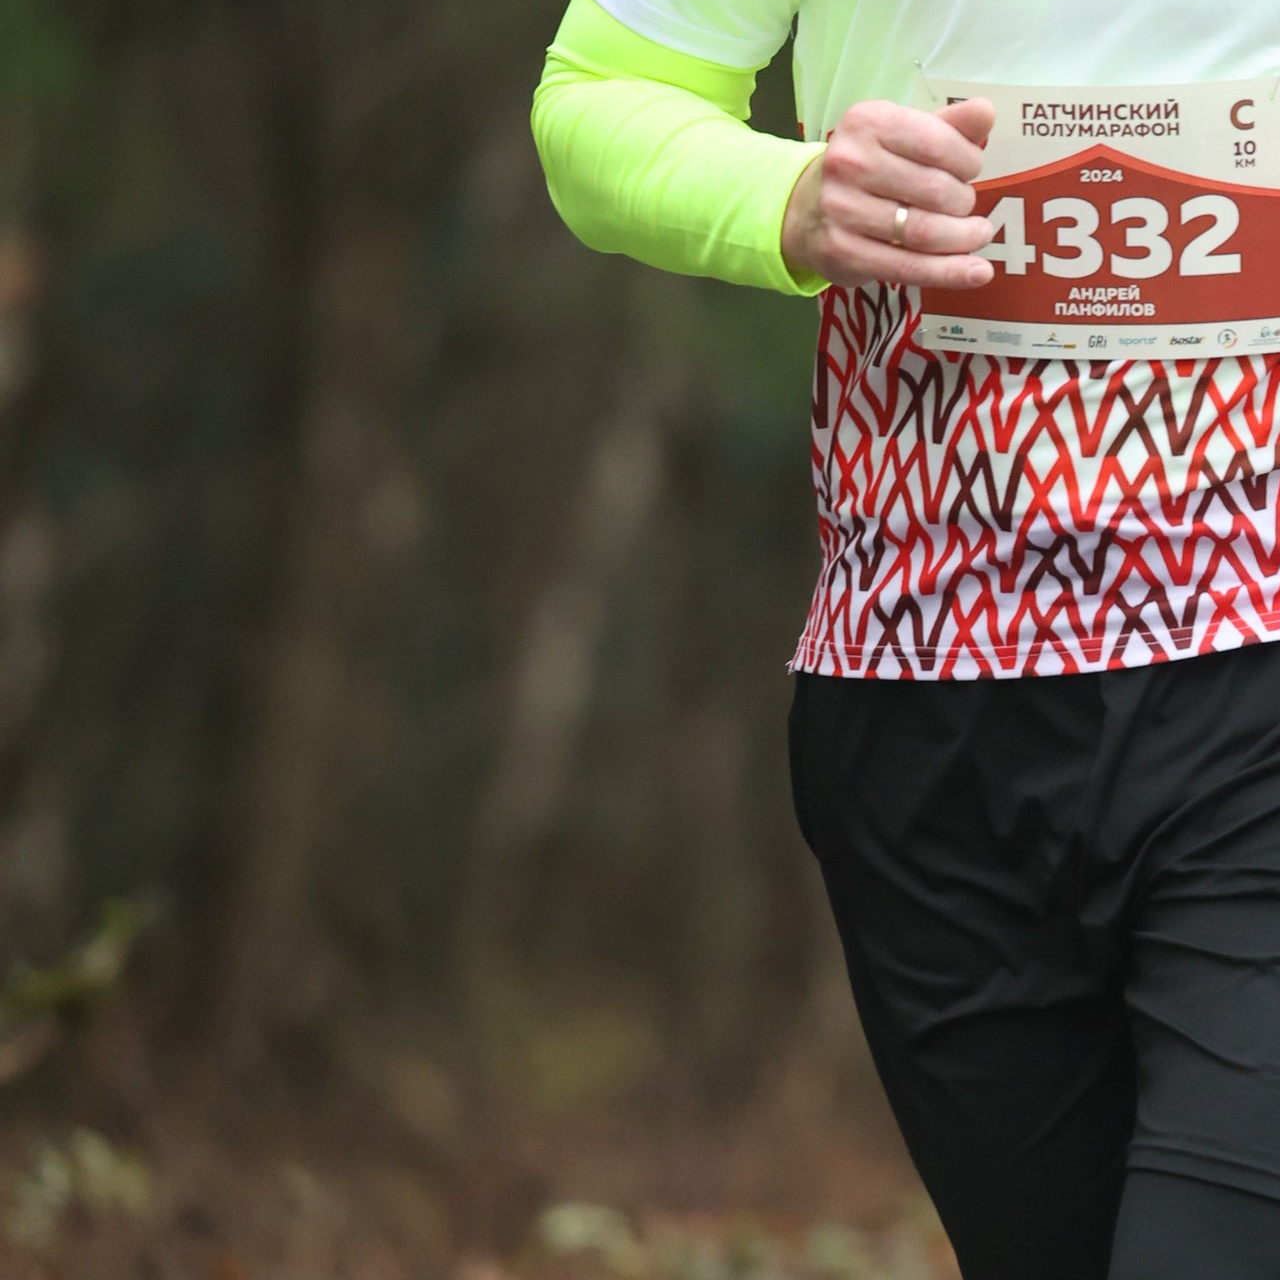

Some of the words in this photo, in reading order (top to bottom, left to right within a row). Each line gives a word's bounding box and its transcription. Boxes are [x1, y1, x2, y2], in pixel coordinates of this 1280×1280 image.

[1021, 98, 1180, 121] ГАТЧИНСКИЙ
[1021, 122, 1180, 138] ПОЛУМАРАФОН
[1233, 140, 1257, 156] 10
[1079, 169, 1124, 183] 2024
[970, 194, 1242, 279] 4332
[1068, 285, 1140, 302] АНДРЕЙ
[1053, 302, 1156, 317] ПАНФИЛОВ
